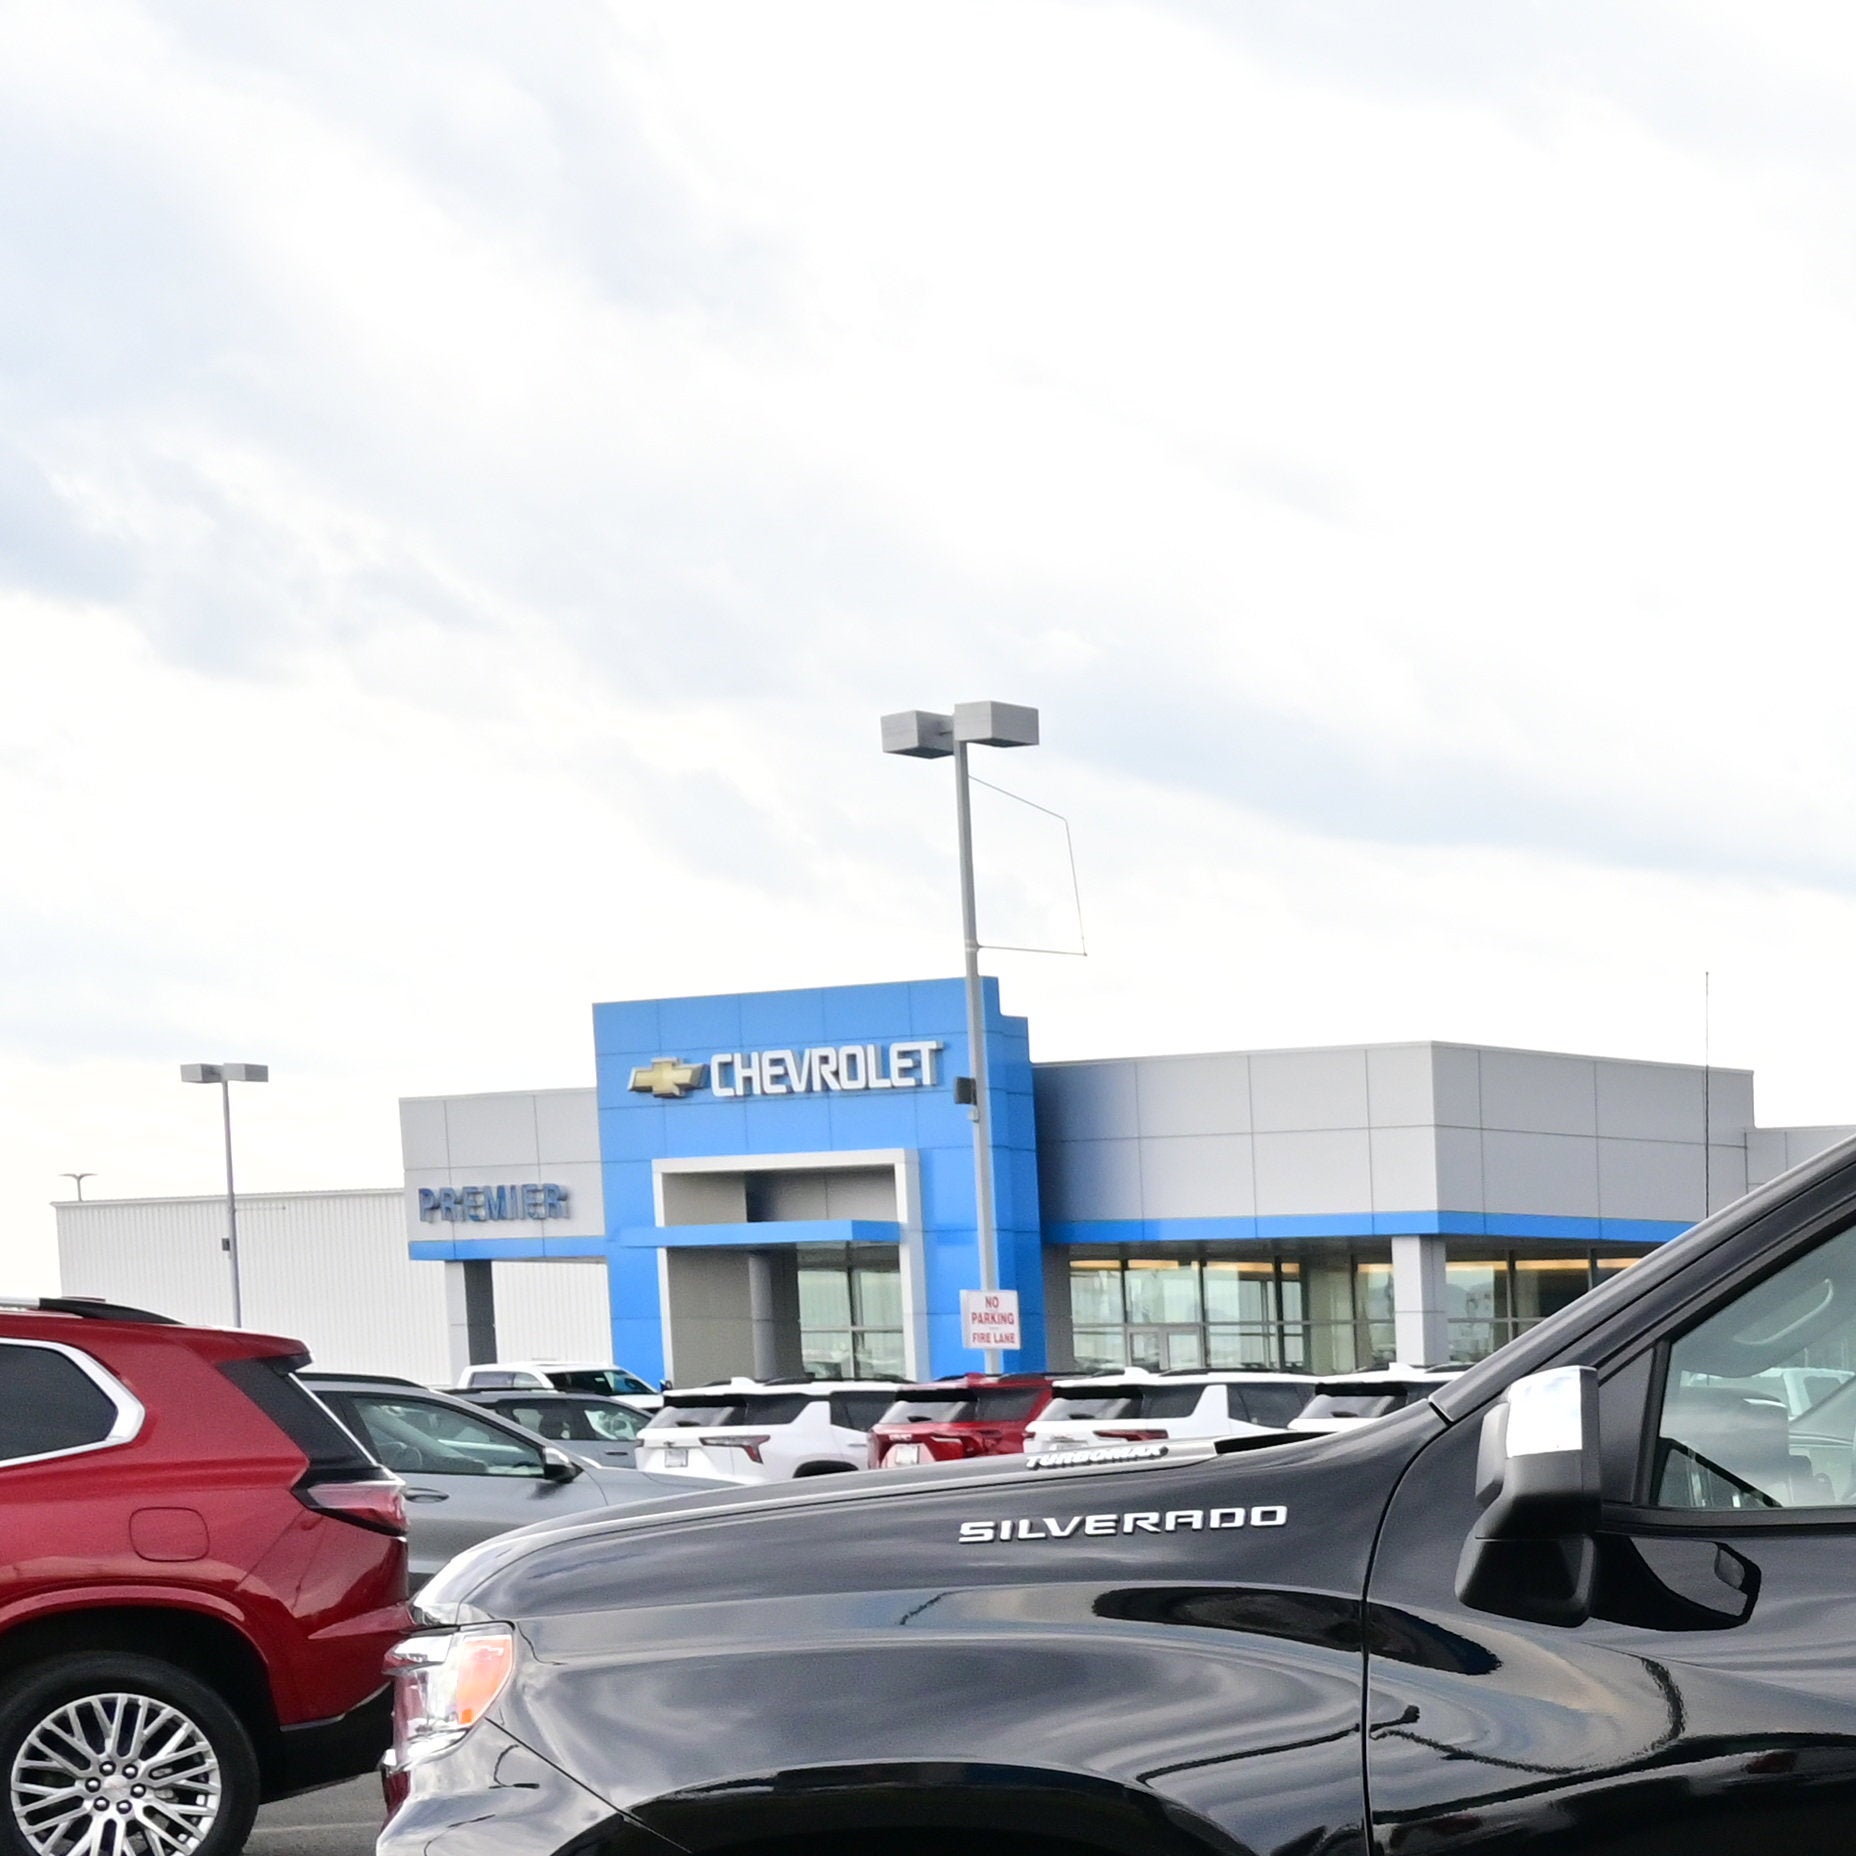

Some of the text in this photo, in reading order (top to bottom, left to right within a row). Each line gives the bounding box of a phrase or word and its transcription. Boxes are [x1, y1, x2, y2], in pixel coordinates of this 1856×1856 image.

[710, 1040, 944, 1097] CHEVROLET
[418, 1183, 572, 1224] PREMIER
[985, 1296, 1000, 1309] NO
[971, 1312, 1014, 1325] PARKING
[972, 1332, 1016, 1344] FIRE LANE
[1025, 1444, 1164, 1470] TURBOMAX
[958, 1505, 1289, 1544] SILVERADO
